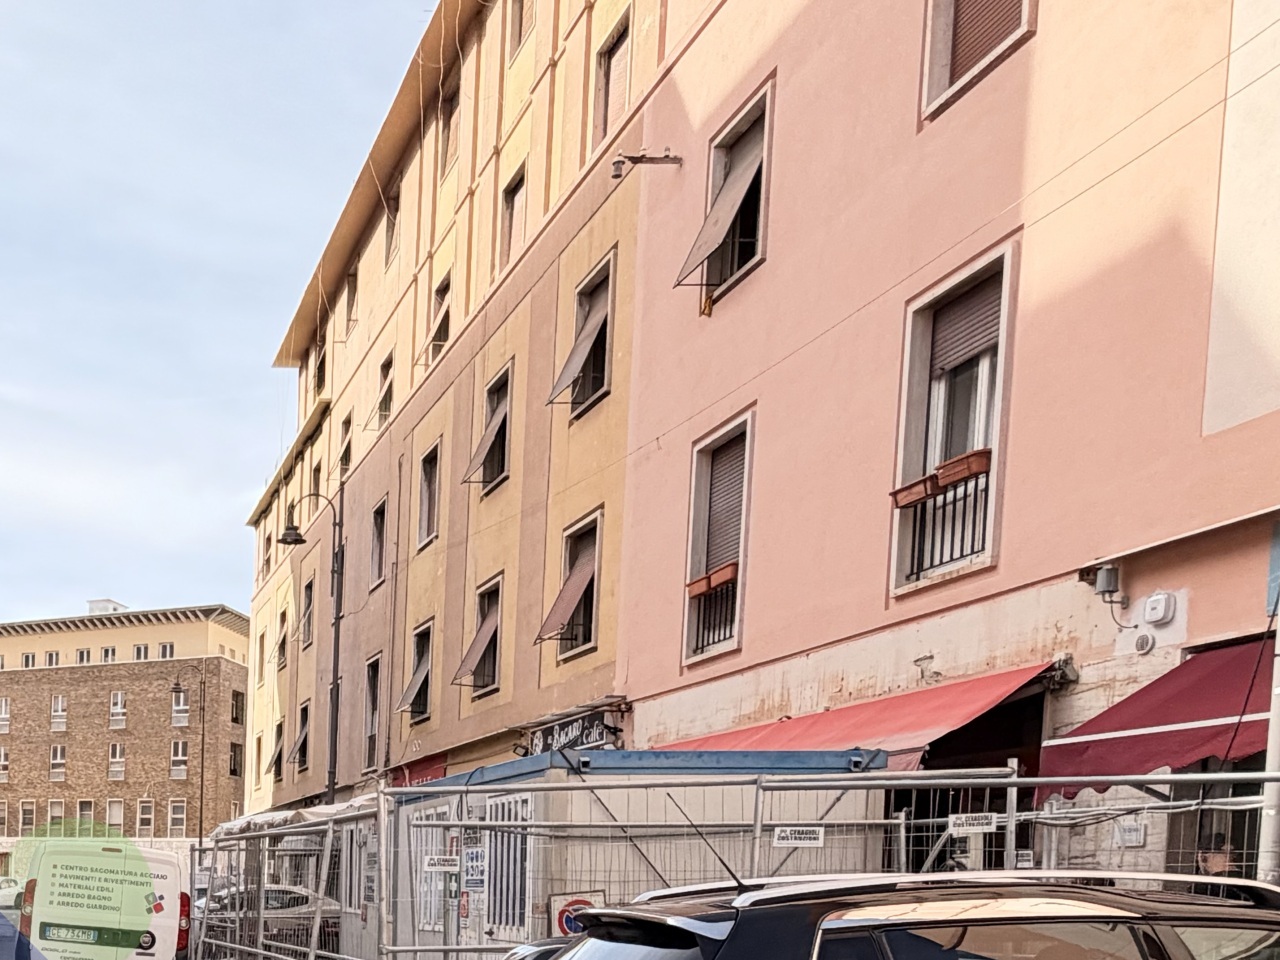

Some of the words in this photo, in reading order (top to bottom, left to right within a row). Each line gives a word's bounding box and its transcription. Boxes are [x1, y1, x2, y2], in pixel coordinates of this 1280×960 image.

[60, 864, 89, 872] CENTRO
[90, 867, 138, 877] SAGOMATURA
[139, 872, 168, 880] ACCIAIO
[59, 873, 97, 882] PAVIMENTI
[103, 878, 152, 888] RIVESTIMENTI
[58, 883, 96, 891] MATERIALI
[87, 894, 112, 902] BAGNO
[86, 902, 121, 912] GIARDINO
